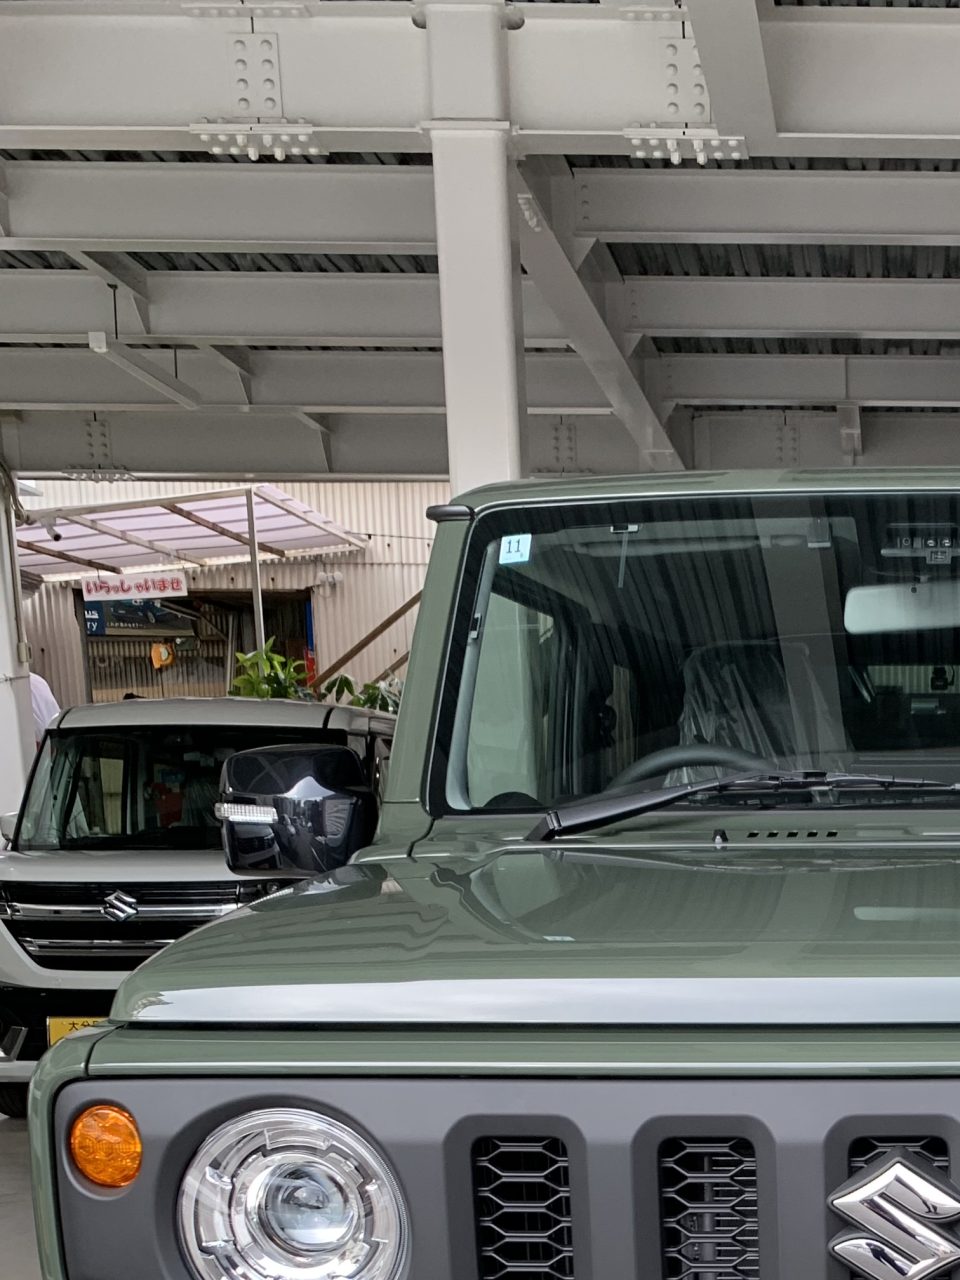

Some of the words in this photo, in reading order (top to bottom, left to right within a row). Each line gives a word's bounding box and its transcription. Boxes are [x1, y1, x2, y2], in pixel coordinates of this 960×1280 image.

[506, 538, 521, 554] 11
[86, 577, 183, 595] いらっしゃいませ
